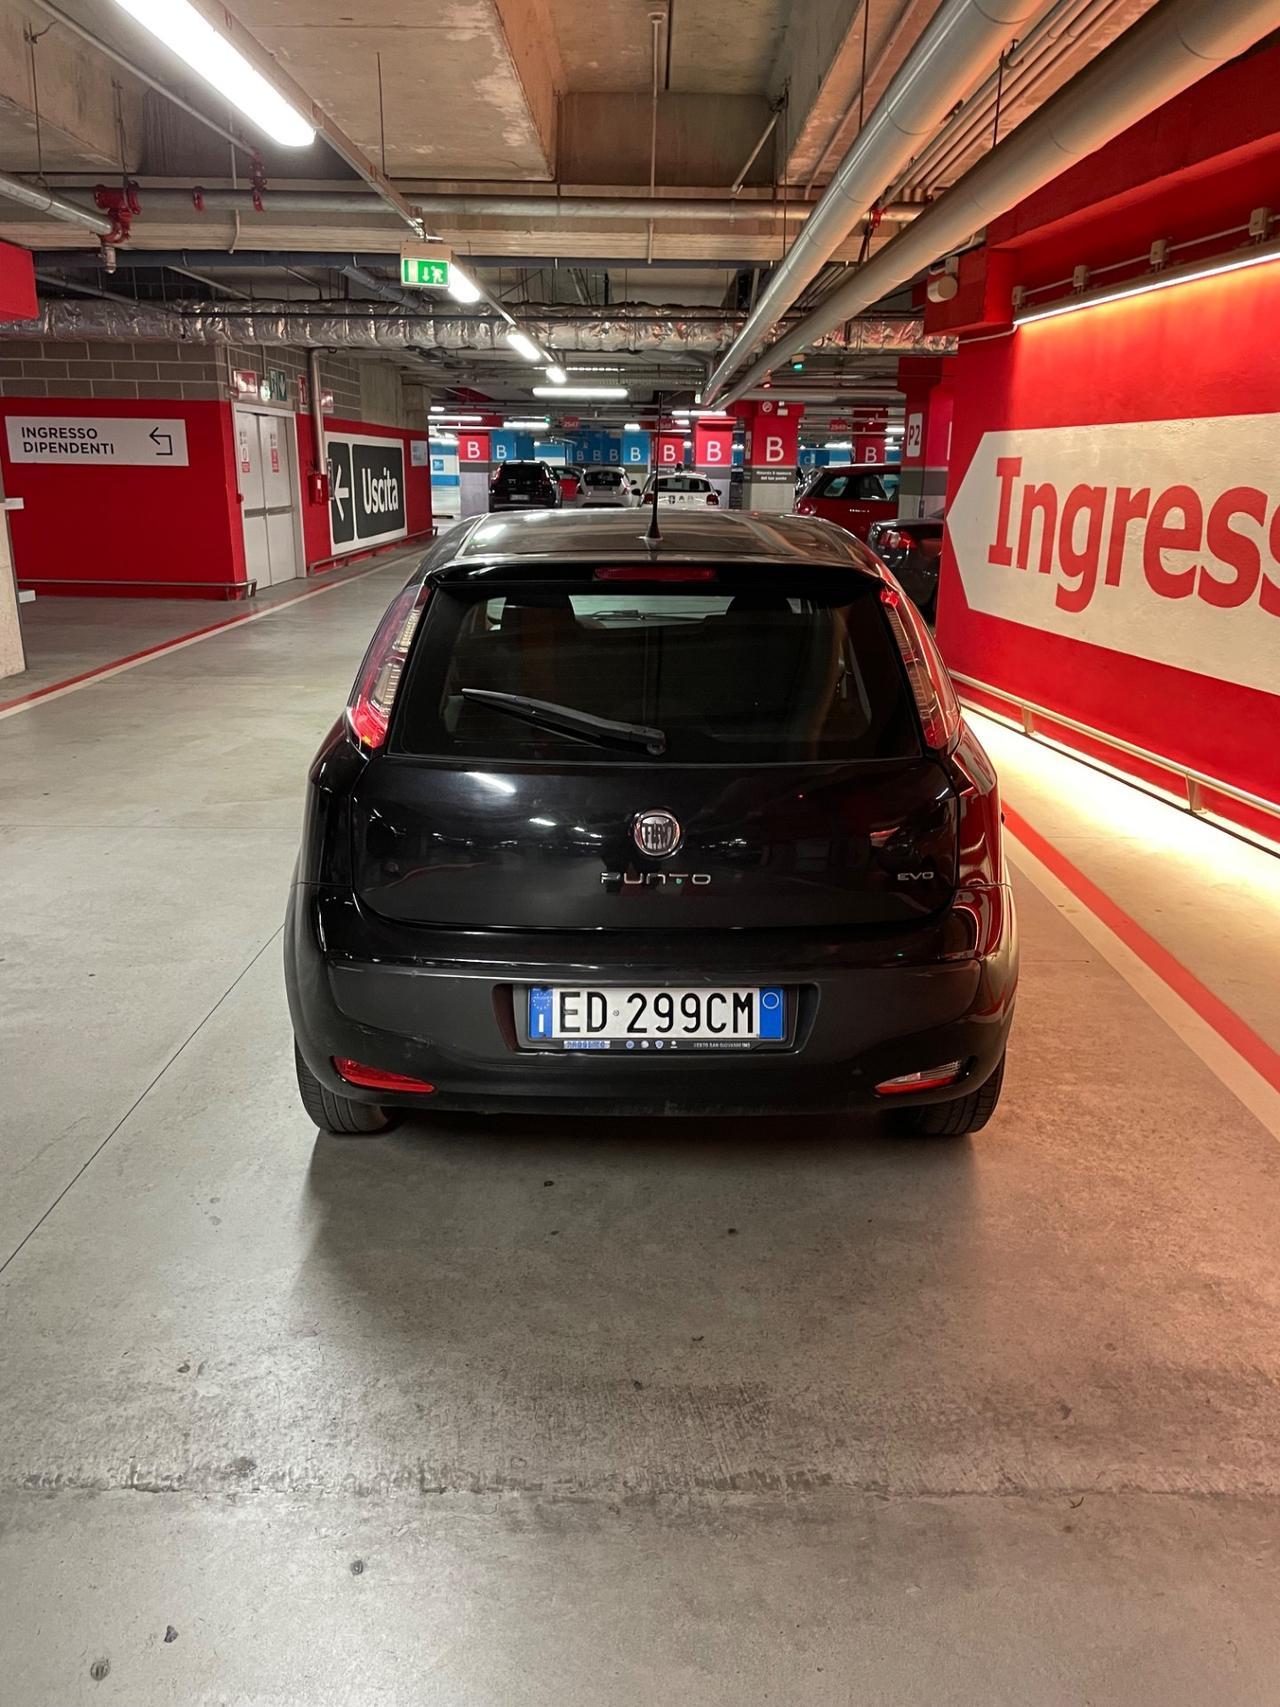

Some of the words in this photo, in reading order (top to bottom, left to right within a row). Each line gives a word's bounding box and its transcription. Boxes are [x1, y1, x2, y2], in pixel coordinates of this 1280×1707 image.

[21, 426, 98, 440] INGRESSO
[908, 425, 920, 446] P2
[23, 441, 114, 455] DIPENDENTI
[467, 441, 480, 458] B
[496, 445, 507, 459] B
[609, 449, 618, 460] B
[630, 447, 641, 461] B
[663, 445, 676, 461] B
[706, 440, 722, 462] B
[766, 436, 784, 462] B
[865, 446, 877, 463] B
[362, 467, 399, 514] Uscita
[988, 456, 1280, 618] Ingres
[641, 822, 676, 851] FIAT
[601, 872, 711, 885] PUNTO
[897, 871, 935, 881] EVO
[560, 991, 608, 1033] ED
[626, 991, 754, 1033] 299CM
